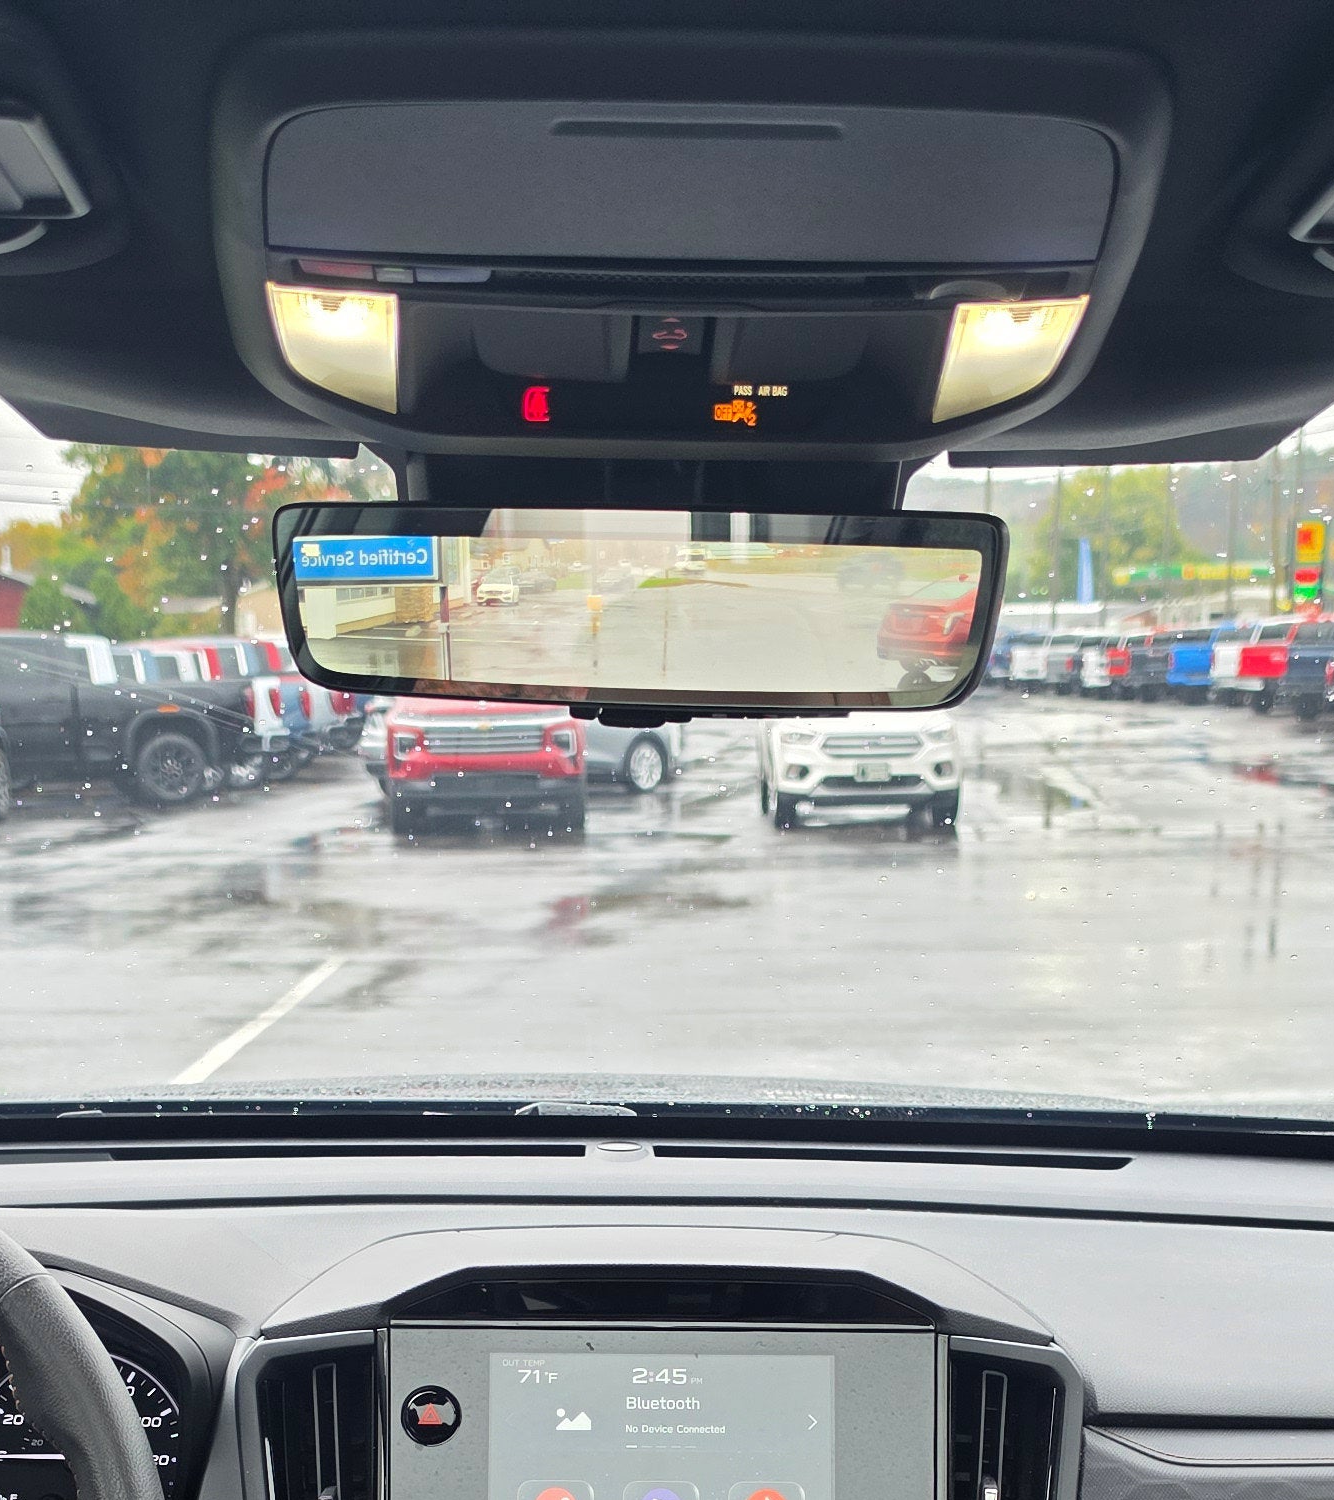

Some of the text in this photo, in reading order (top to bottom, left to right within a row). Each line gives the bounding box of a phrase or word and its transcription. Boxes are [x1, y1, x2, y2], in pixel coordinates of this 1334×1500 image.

[733, 385, 788, 397] PASS AIR BAG
[502, 1359, 545, 1367] OUT TEMP
[631, 1367, 703, 1385] 2:45 PM
[625, 1396, 701, 1410] Bluetooth
[2, 1414, 24, 1426] 20
[139, 1416, 162, 1428] 00
[625, 1424, 726, 1434] No Device Connected
[31, 1439, 44, 1447] 20
